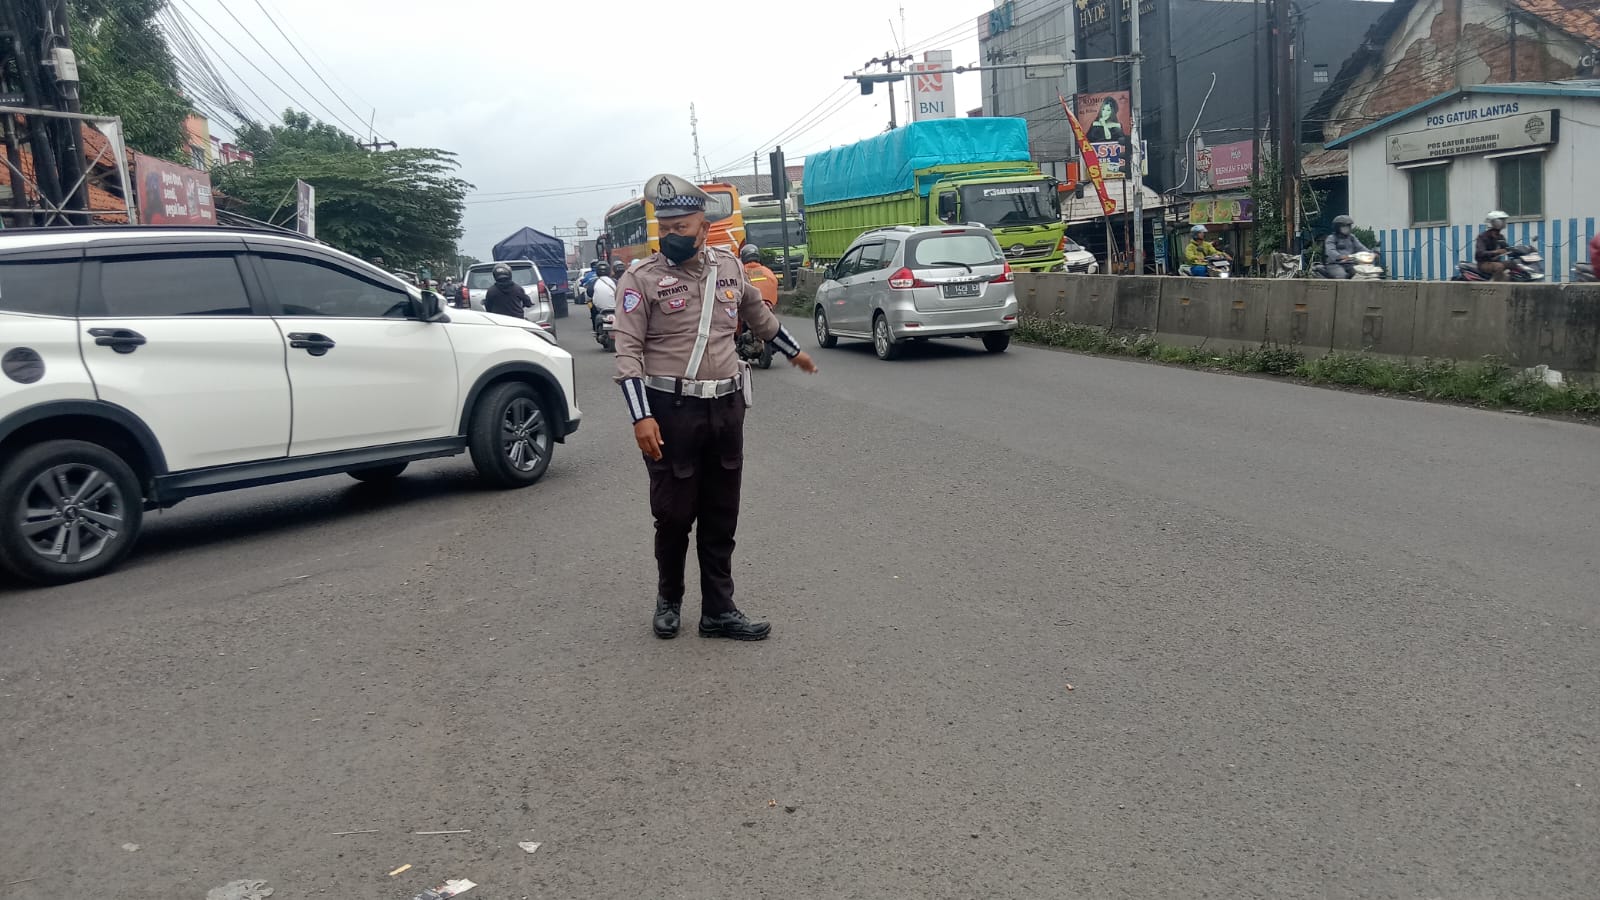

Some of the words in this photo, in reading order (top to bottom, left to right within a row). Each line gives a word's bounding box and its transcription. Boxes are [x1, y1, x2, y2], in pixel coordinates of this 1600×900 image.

[1080, 3, 1106, 28] HYDE
[919, 101, 945, 114] BNI
[1426, 115, 1444, 127] POS
[1446, 108, 1478, 123] GATUR
[1480, 102, 1519, 118] LANTAS
[1442, 137, 1464, 148] GATUR
[1465, 133, 1500, 144] KOSAMBI
[1429, 146, 1454, 157] POLRES
[1456, 142, 1497, 153] KARAWANG
[657, 284, 689, 298] PRIYANTO
